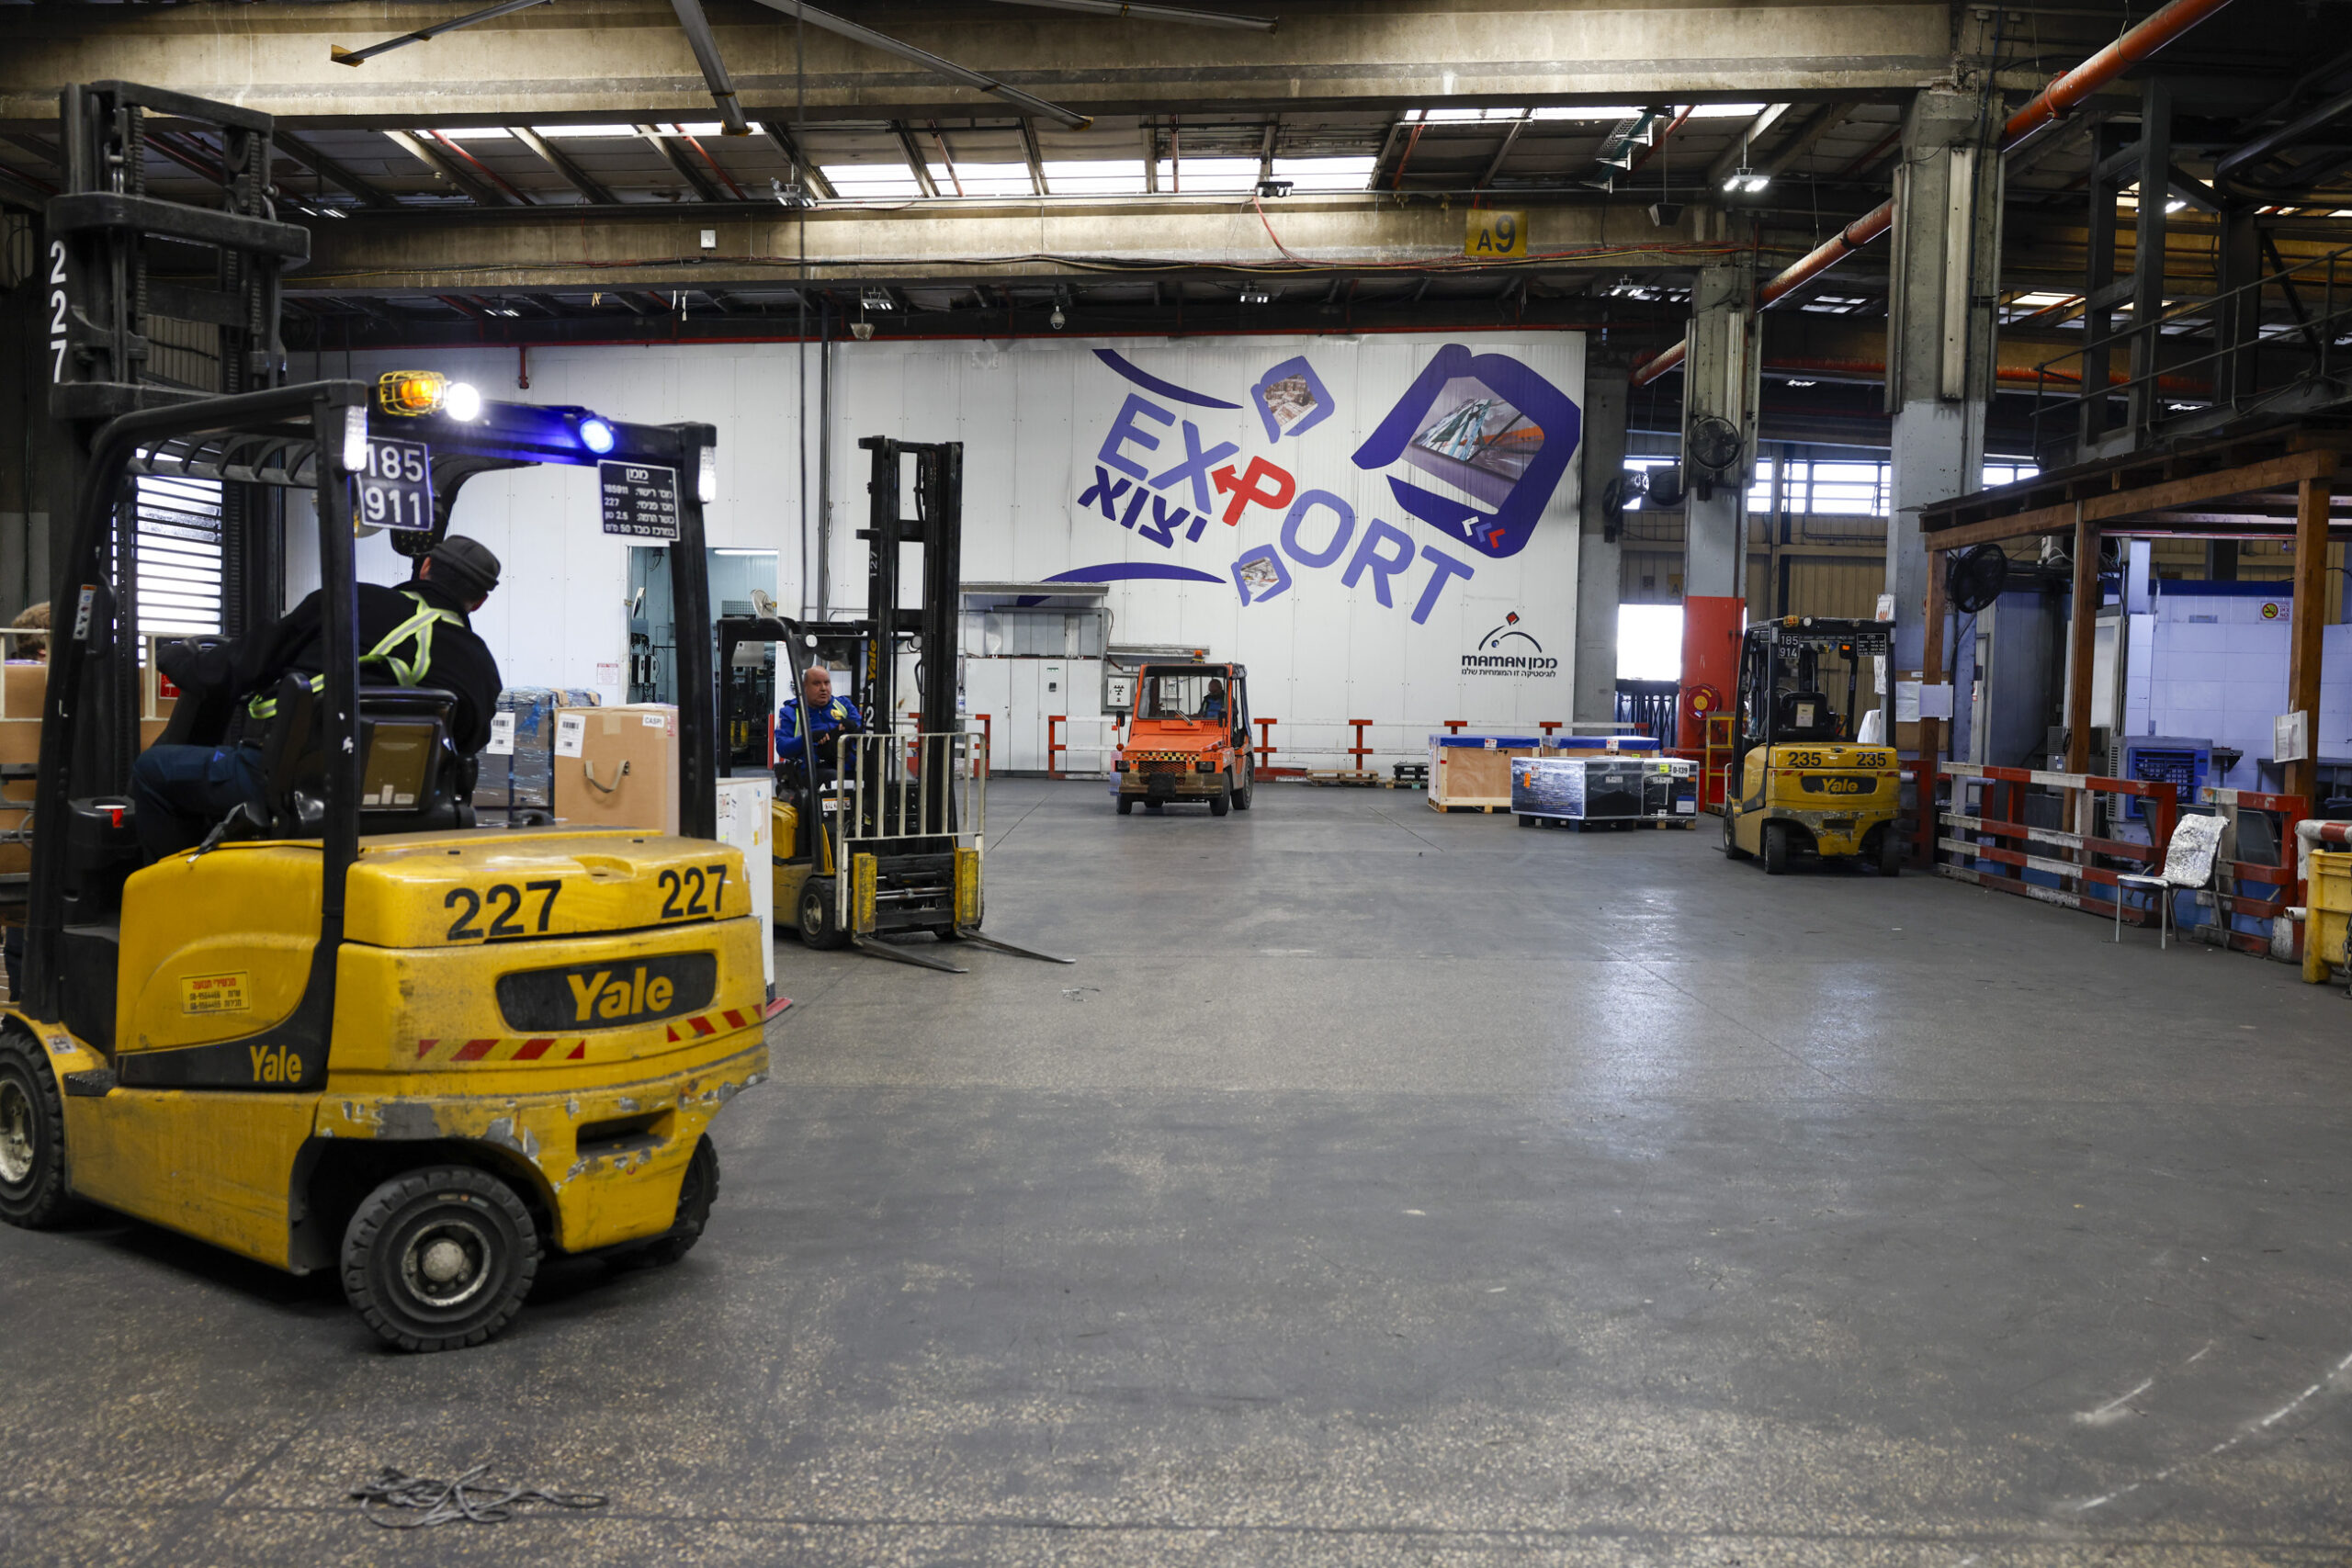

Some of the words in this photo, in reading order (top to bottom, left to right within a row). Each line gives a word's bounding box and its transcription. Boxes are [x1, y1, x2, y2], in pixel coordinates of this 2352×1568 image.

[50, 240, 67, 384] 227
[367, 443, 424, 482] 185
[365, 486, 422, 525] 911
[604, 484, 629, 494] 185911
[604, 497, 620, 507] 227
[1077, 465, 1207, 548] יצוא
[1097, 392, 1475, 626] EXPORT
[619, 524, 631, 533] 50
[867, 638, 878, 681] Yale
[1780, 647, 1798, 658] 914
[1781, 635, 1799, 646] 185
[1788, 751, 1821, 767] 235
[1856, 752, 1887, 767] 235
[1822, 778, 1859, 793] Yale
[444, 879, 561, 941] 227
[658, 864, 727, 919] 227
[567, 967, 674, 1021] Yale
[249, 1045, 302, 1083] Yale
